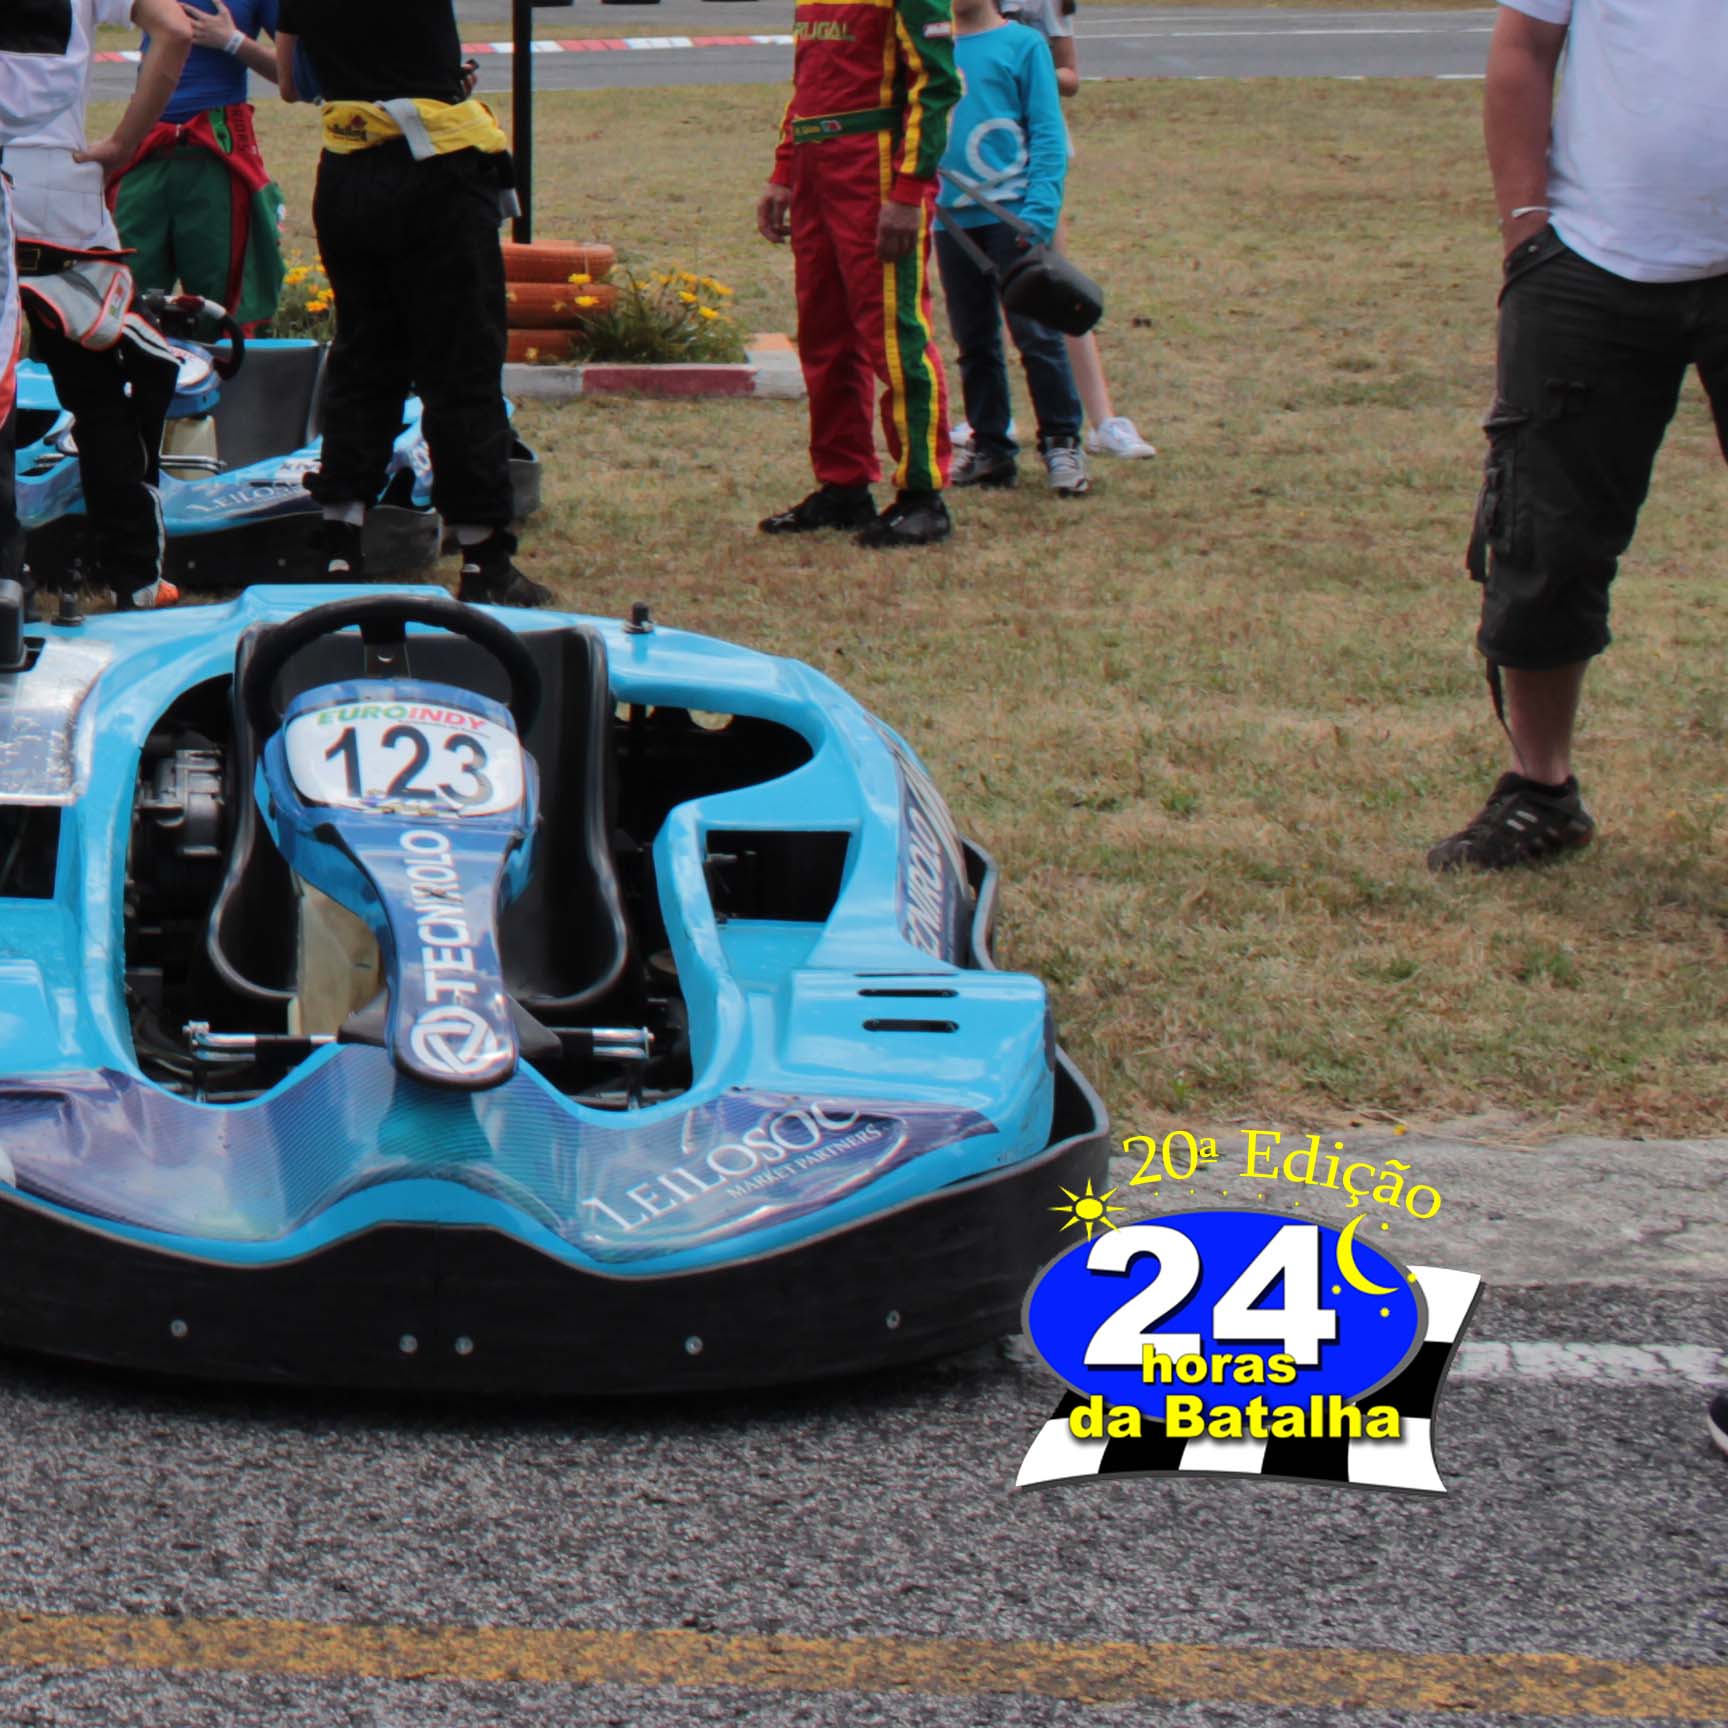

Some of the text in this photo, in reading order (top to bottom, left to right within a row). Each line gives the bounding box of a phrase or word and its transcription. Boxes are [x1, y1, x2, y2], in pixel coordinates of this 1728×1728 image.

[316, 703, 488, 731] EUROINDY
[324, 723, 493, 806] 123
[400, 829, 480, 1003] TECNIROLO
[582, 1101, 862, 1232] LEILOSOC
[728, 1122, 884, 1200] MARKET PARTNERS
